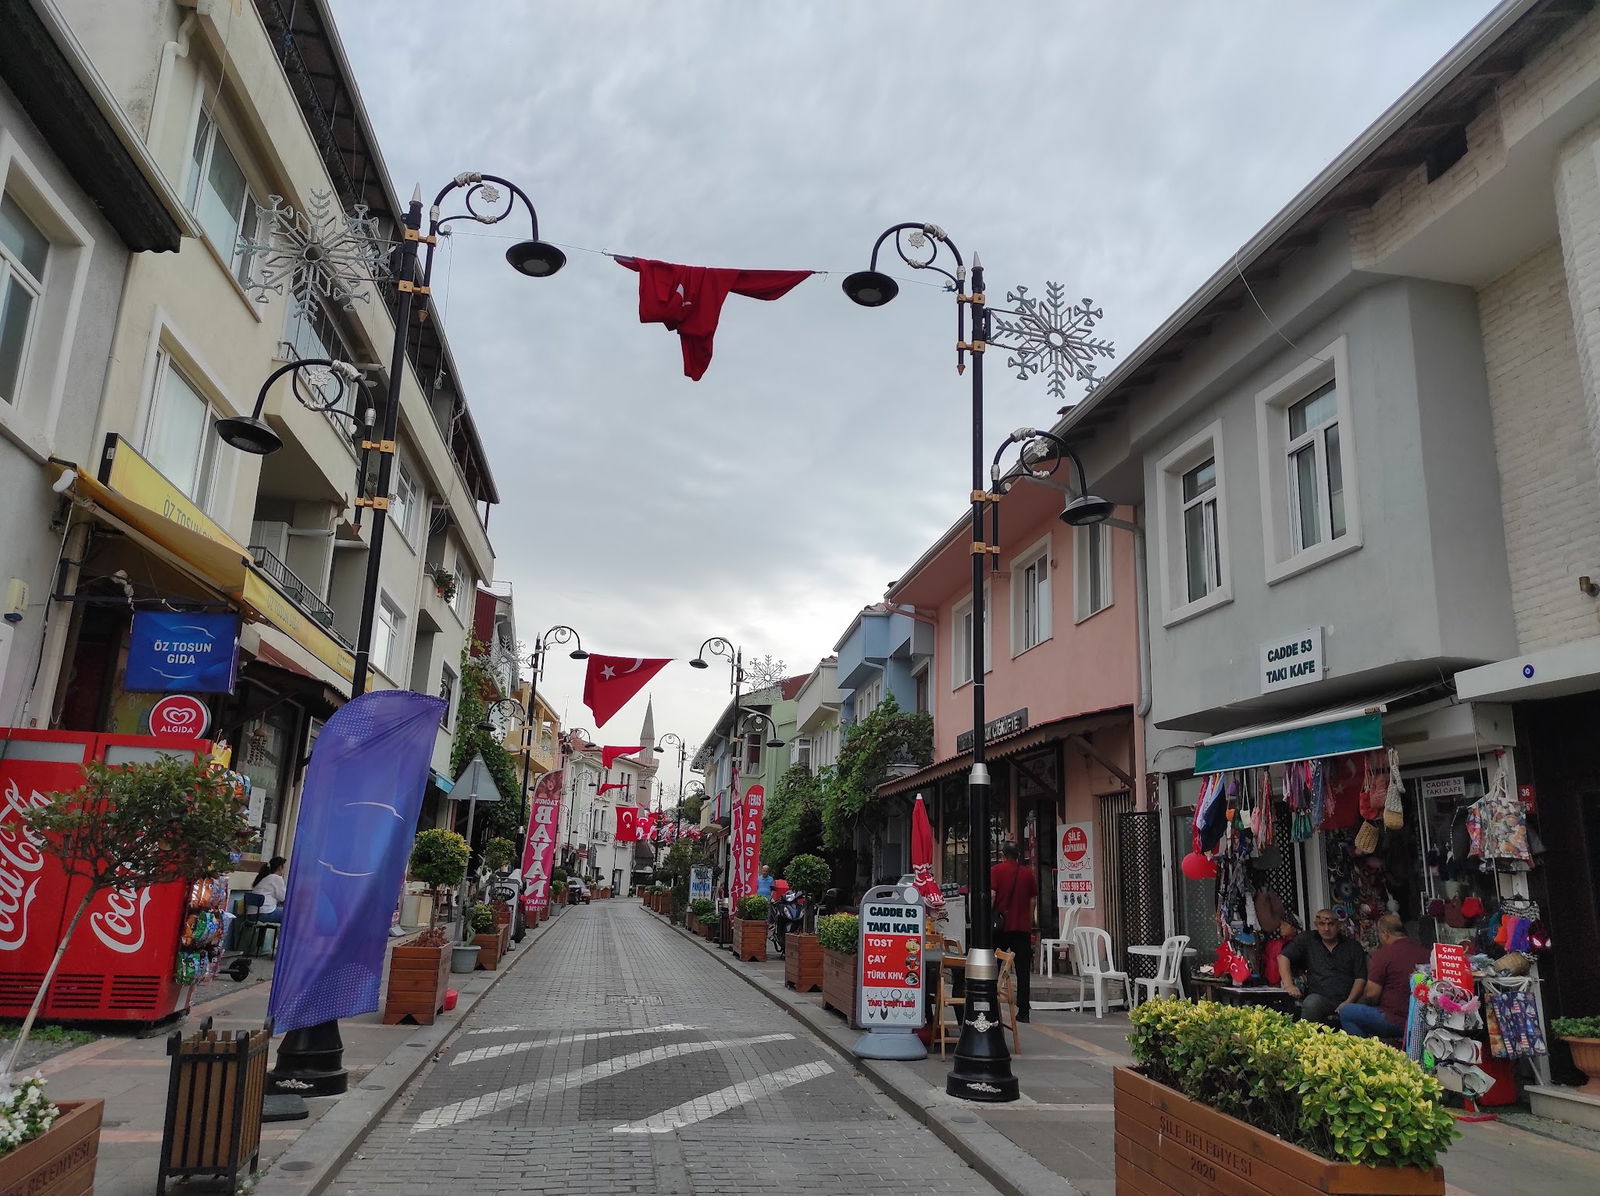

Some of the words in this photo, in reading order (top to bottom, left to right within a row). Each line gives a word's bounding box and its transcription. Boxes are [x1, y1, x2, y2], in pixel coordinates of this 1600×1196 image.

[154, 640, 169, 652] ÖZ
[172, 642, 212, 652] TOSUN
[1268, 642, 1299, 662] CADDE
[1301, 639, 1313, 653] 53
[167, 654, 196, 664] GIDA
[1266, 667, 1287, 683] TAKI
[1290, 660, 1316, 678] KAFE
[160, 725, 194, 734] ALGIDA
[1426, 780, 1451, 789] CADDE
[744, 808, 758, 895] PANSİYO
[870, 907, 903, 918] CADDE
[905, 909, 917, 918] 53
[867, 922, 890, 932] TAKI
[893, 924, 919, 933] KAFE
[868, 939, 893, 947] TOST
[868, 955, 887, 964] ÇAY
[1438, 953, 1463, 962] KAHVE
[867, 970, 886, 979] TÜRK
[1442, 968, 1462, 977] TATLI
[1190, 1157, 1216, 1182] 2020
